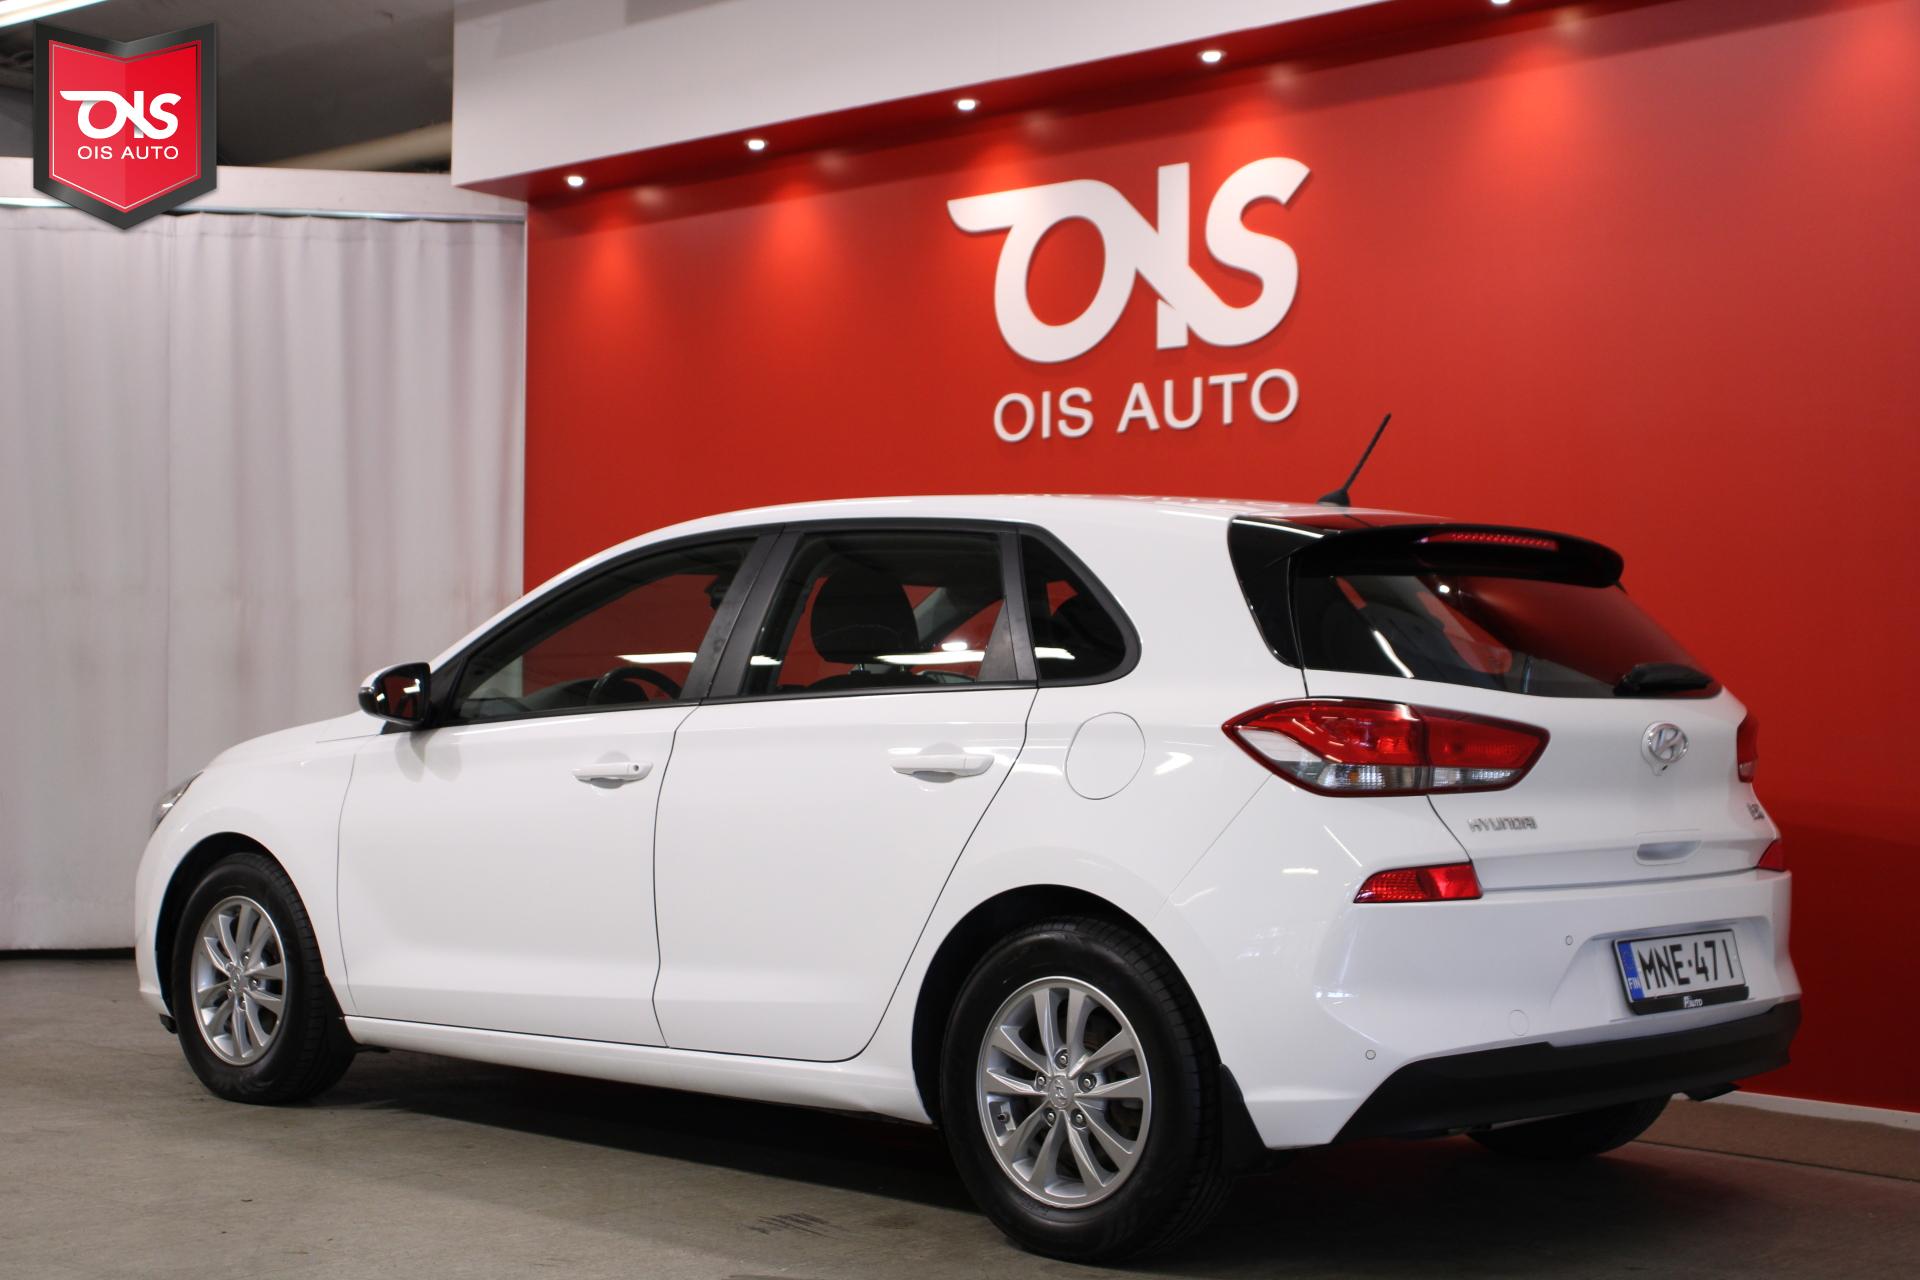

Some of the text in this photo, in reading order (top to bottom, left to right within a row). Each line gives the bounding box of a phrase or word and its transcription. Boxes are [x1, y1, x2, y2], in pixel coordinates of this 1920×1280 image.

[993, 368, 1299, 443] OIS AUTO
[1468, 815, 1538, 832] HYUNDAI
[1637, 938, 1735, 990] MNE-471
